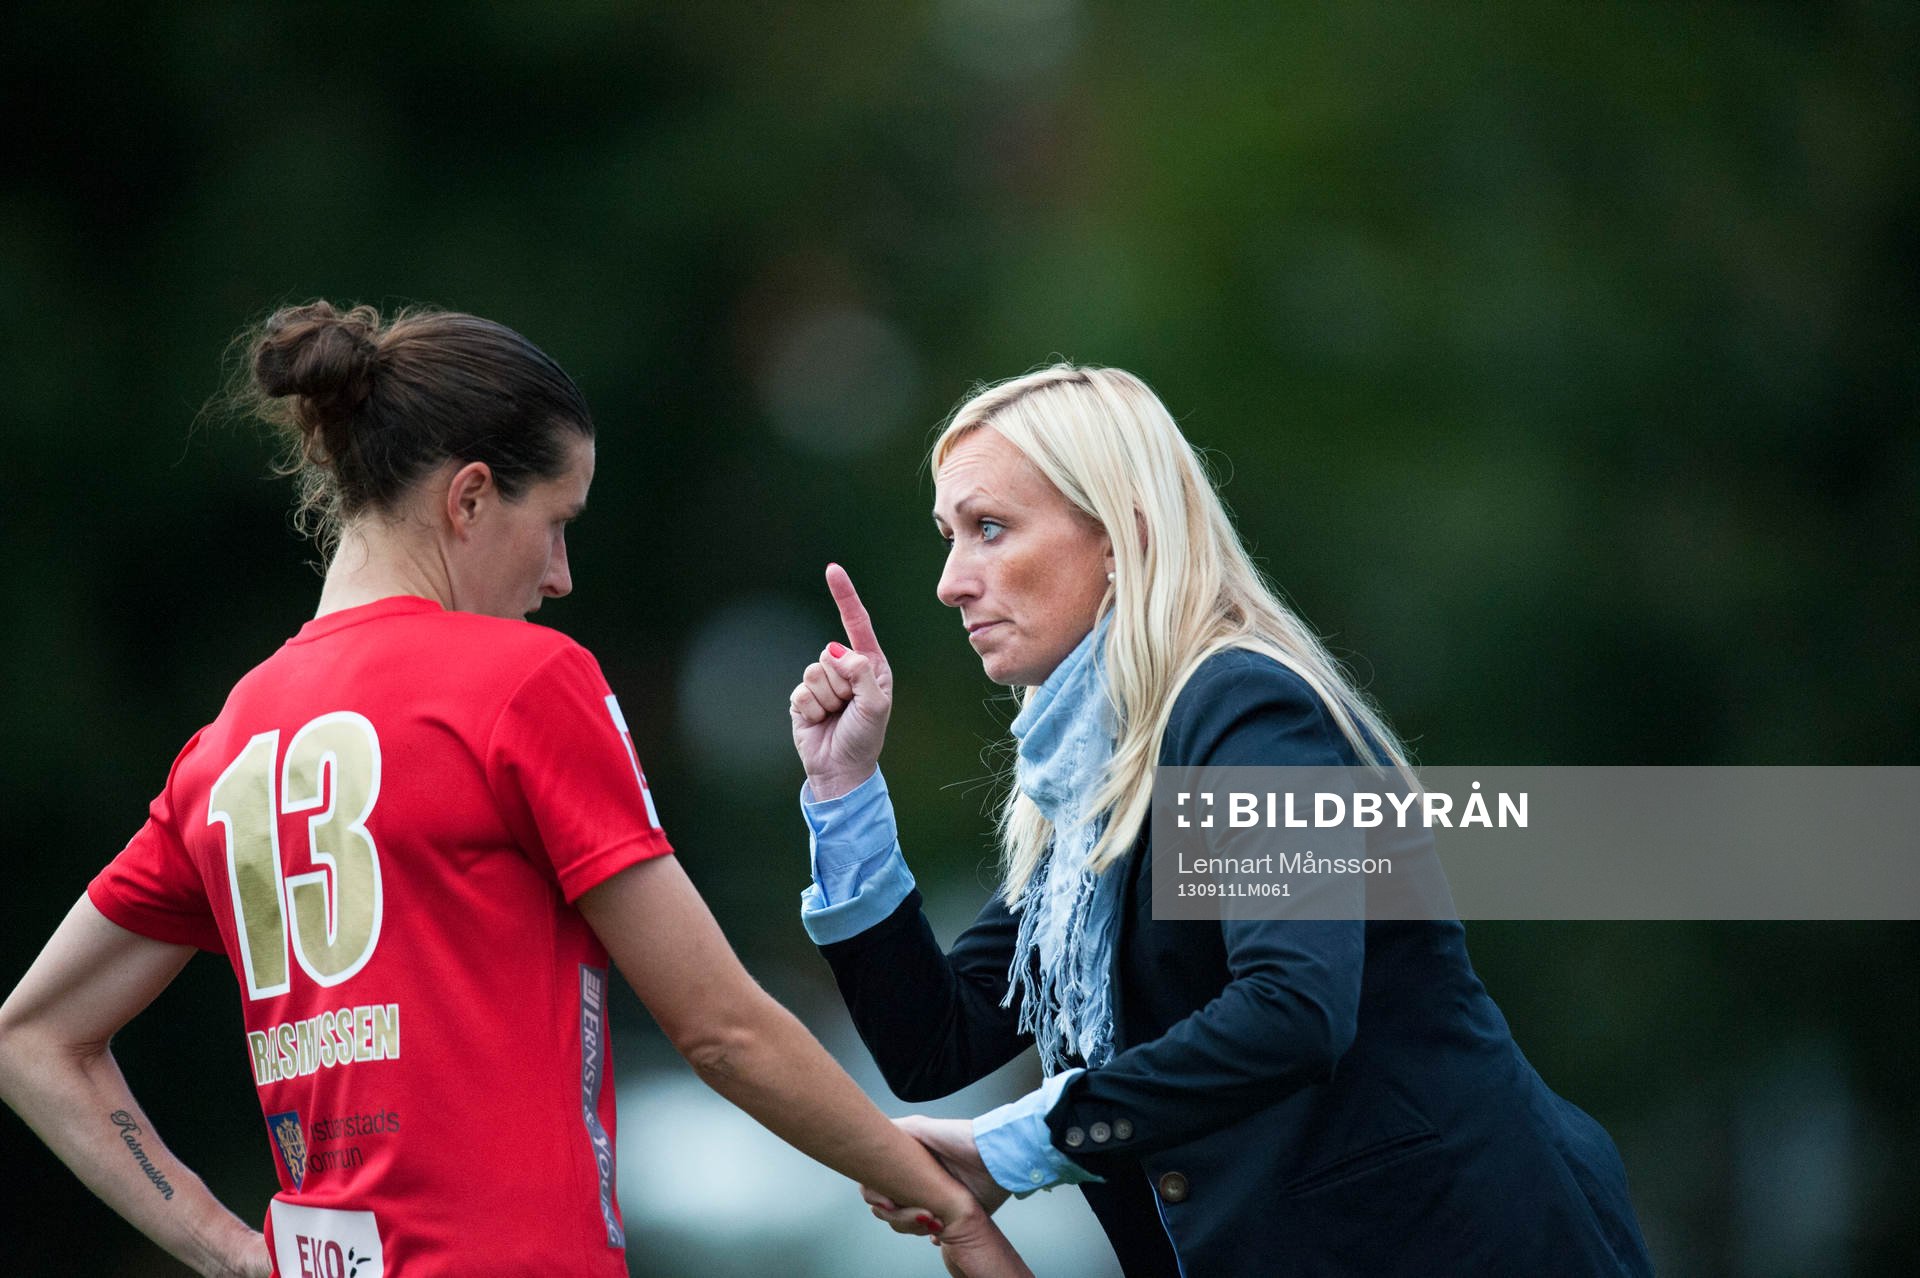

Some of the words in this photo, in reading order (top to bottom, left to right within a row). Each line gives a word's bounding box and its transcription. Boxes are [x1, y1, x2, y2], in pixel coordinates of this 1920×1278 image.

[207, 711, 383, 1001] 13
[583, 1008, 599, 1098] ERNST
[110, 1110, 174, 1201] Rasmussen
[296, 1234, 345, 1278] EKO
